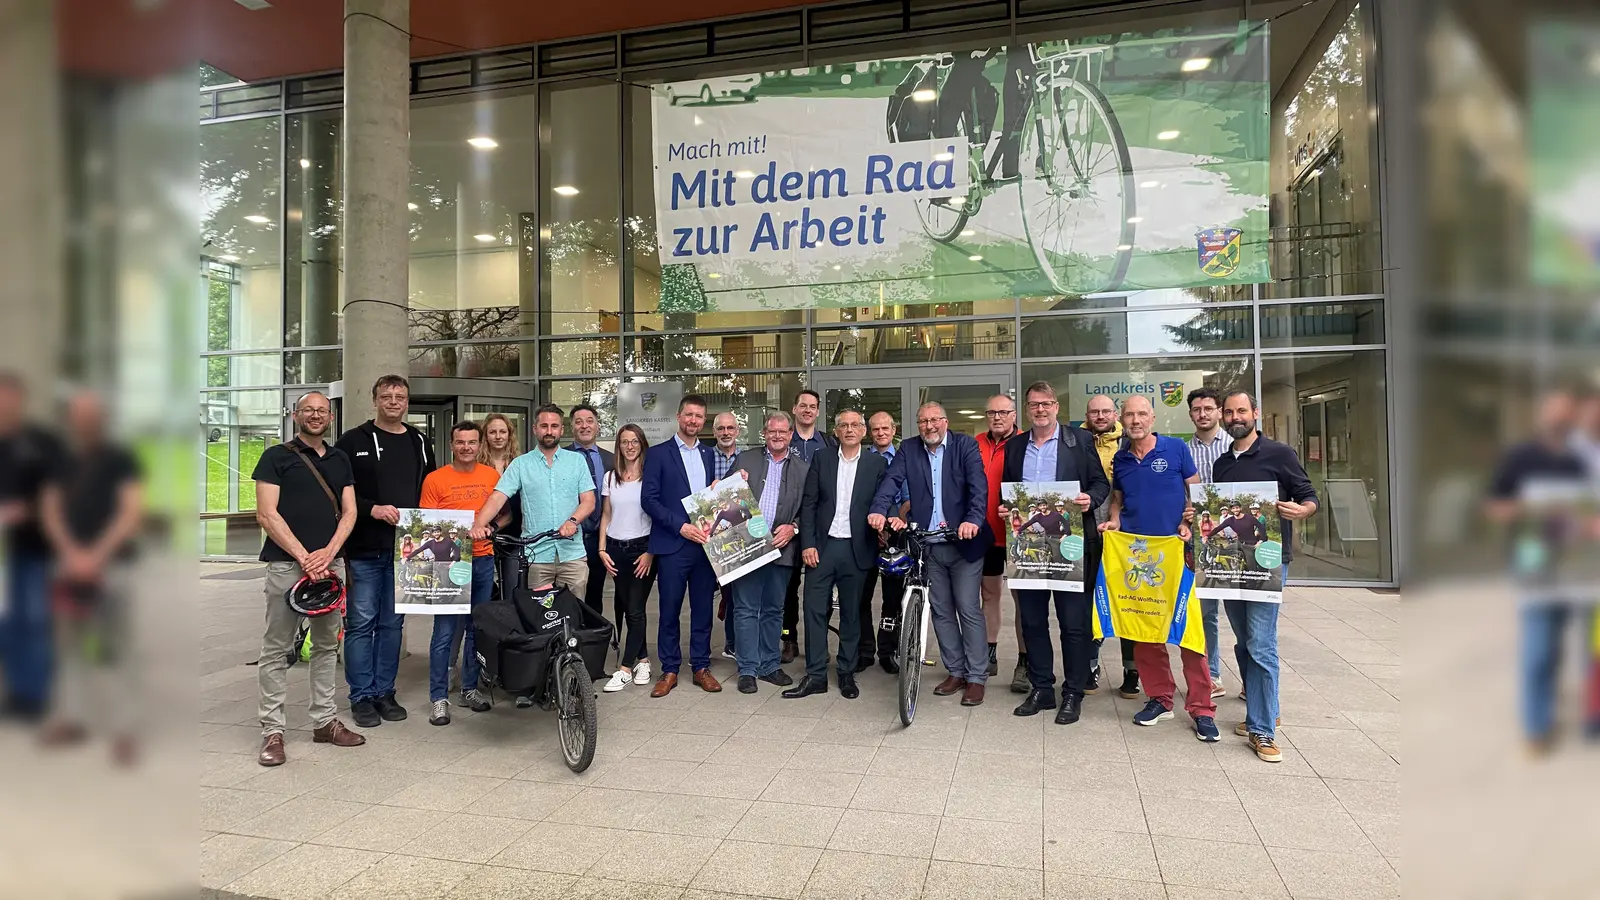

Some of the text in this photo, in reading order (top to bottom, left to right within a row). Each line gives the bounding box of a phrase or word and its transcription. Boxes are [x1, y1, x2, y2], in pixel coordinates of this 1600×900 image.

[668, 135, 767, 162] Mach mit!
[671, 146, 956, 210] Mit dem Rad
[672, 205, 886, 257] zur Arbeit
[1086, 382, 1155, 395] Landkreis
[1137, 596, 1167, 604] Wolfhagen
